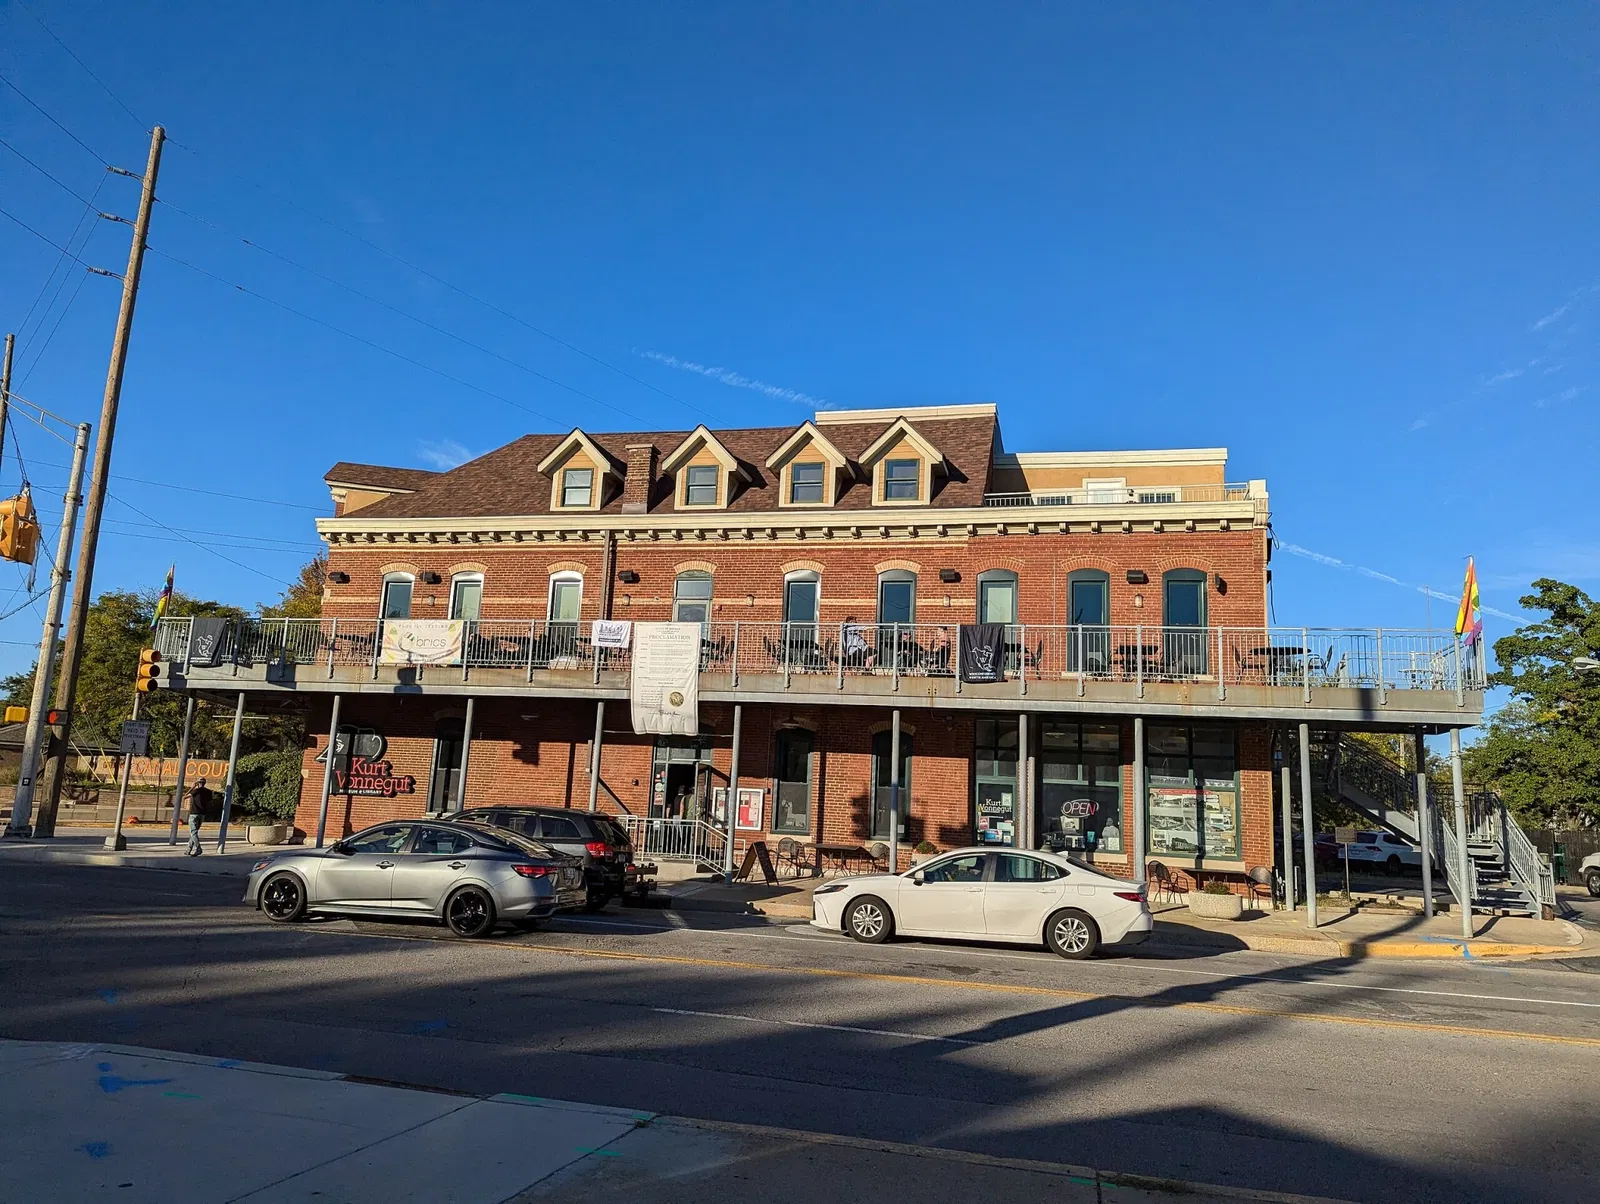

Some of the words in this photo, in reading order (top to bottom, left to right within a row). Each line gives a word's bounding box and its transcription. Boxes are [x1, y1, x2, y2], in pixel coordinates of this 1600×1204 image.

[136, 759, 179, 776] CANAL
[350, 757, 388, 776] Kurt
[336, 771, 410, 795] Vonnegut
[985, 798, 1002, 807] Kurt
[1062, 801, 1096, 815] OPEN
